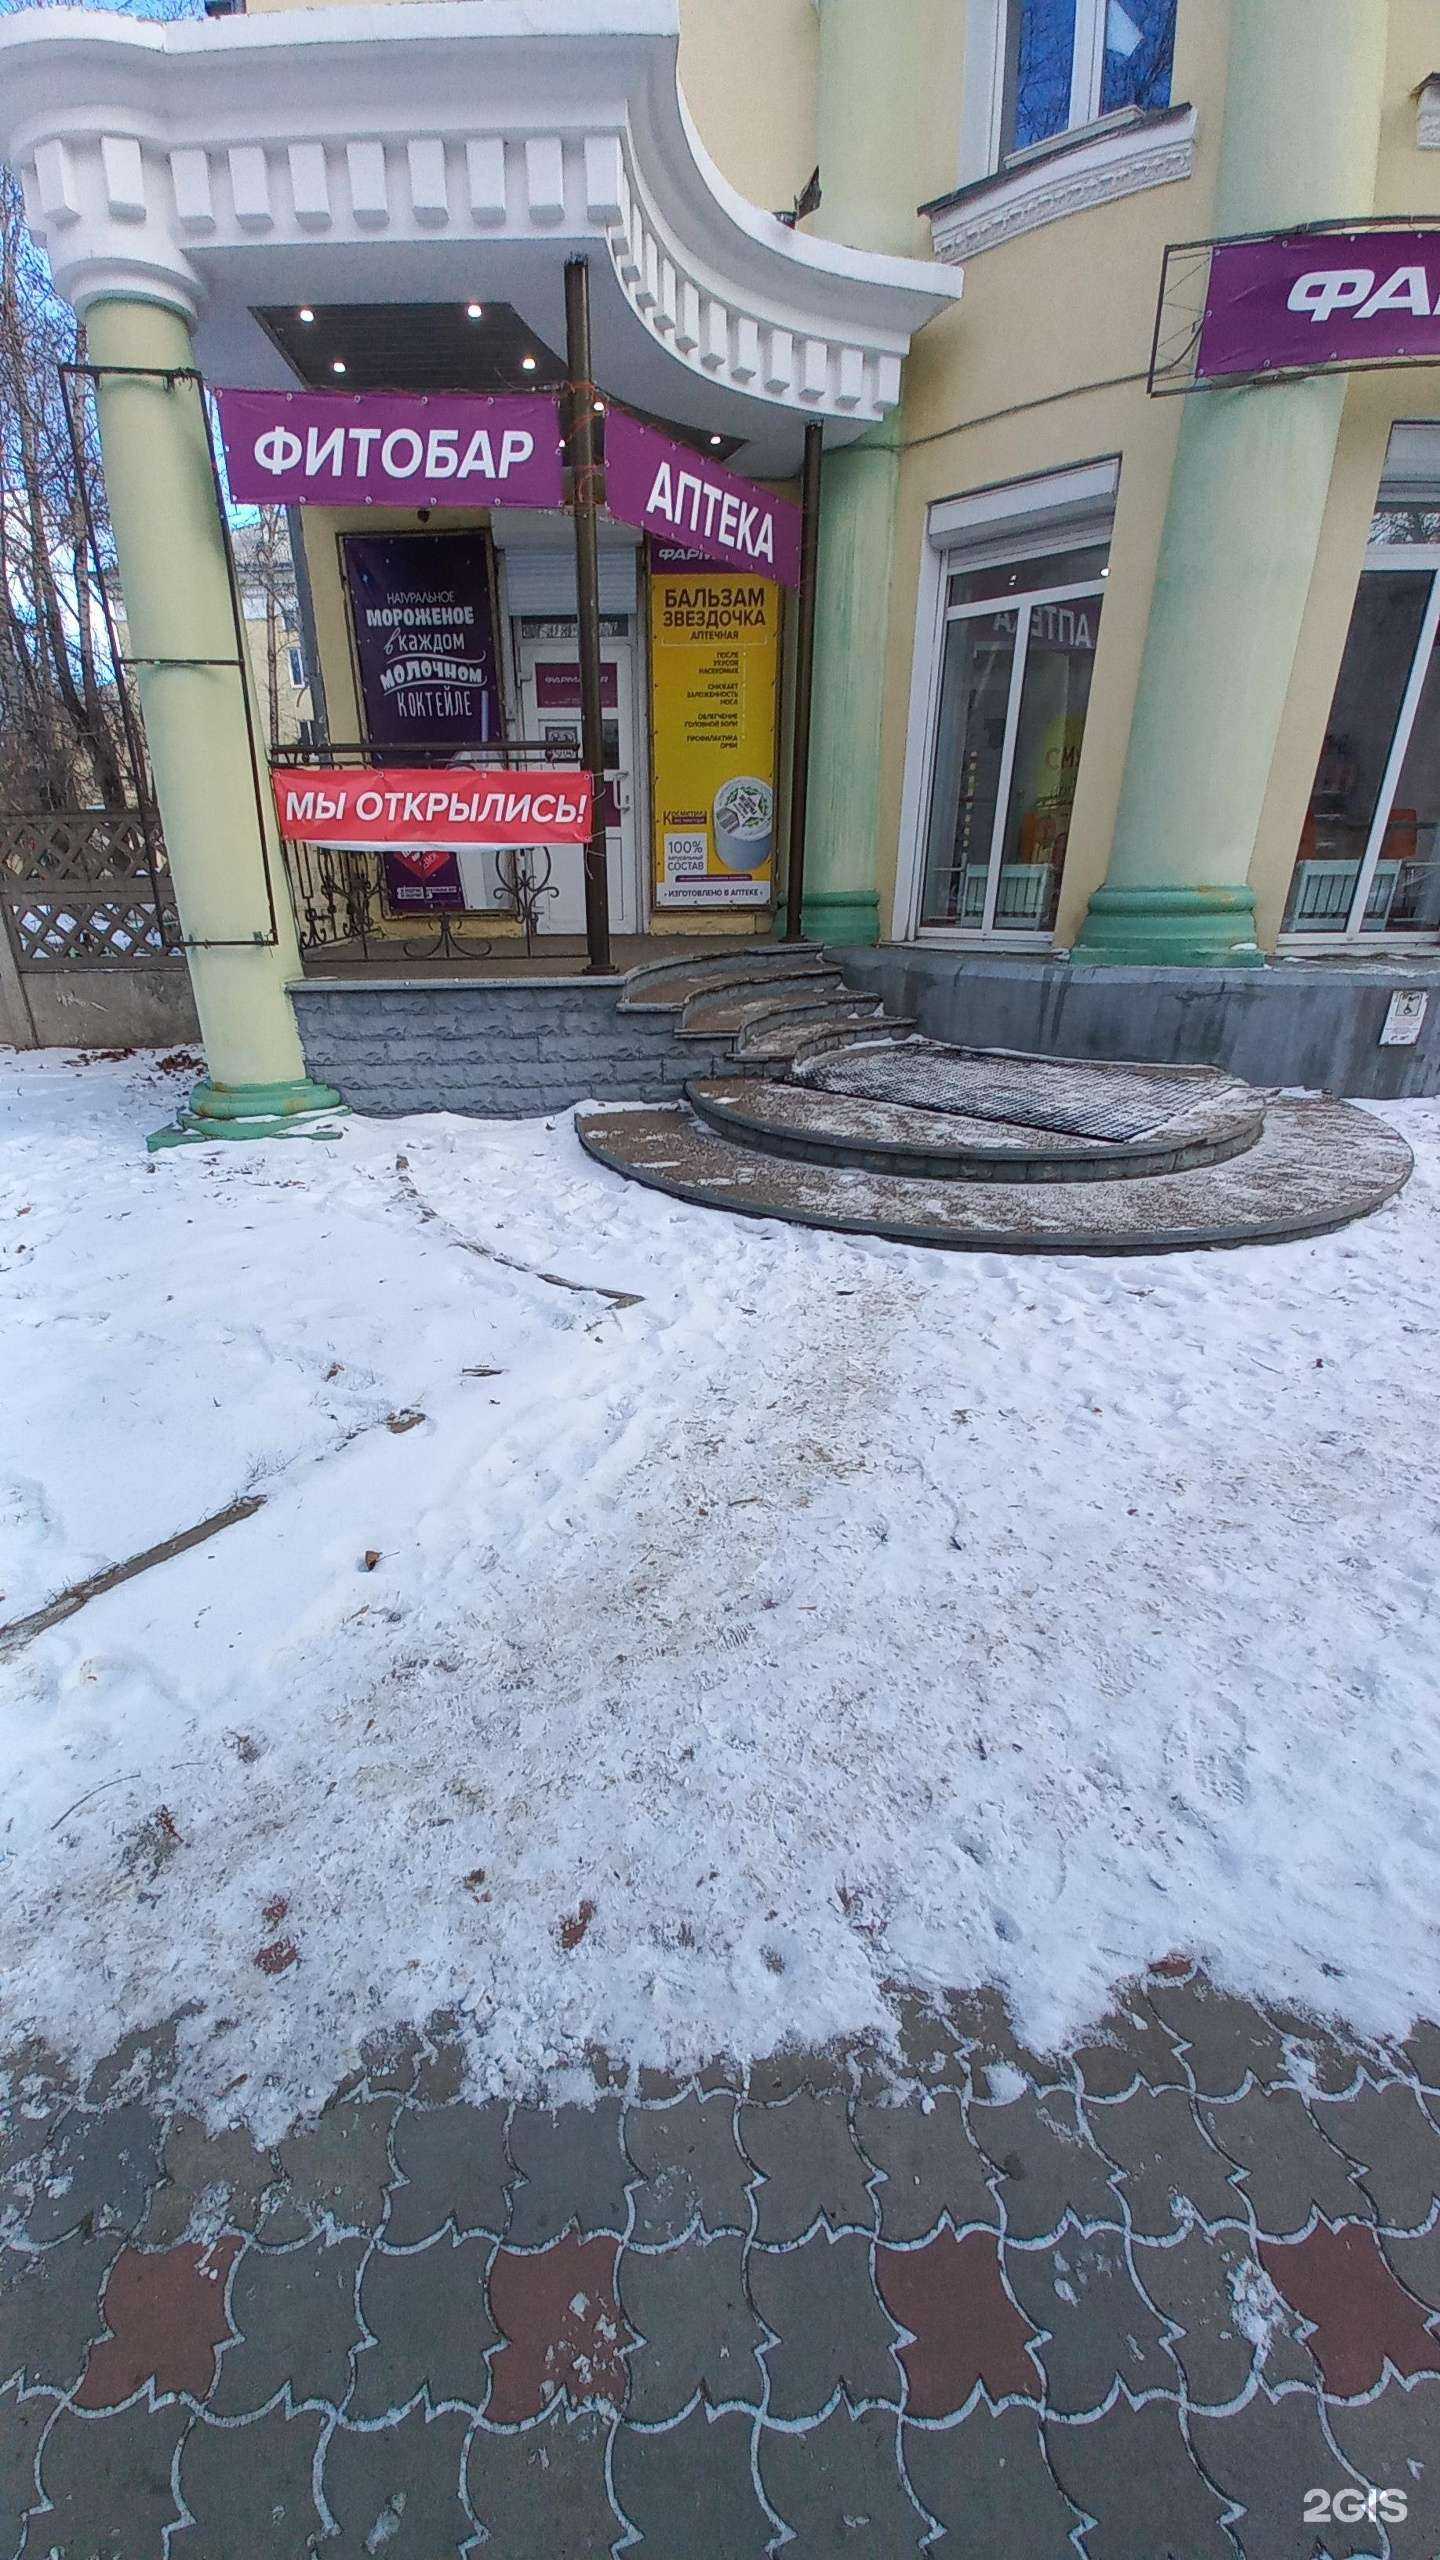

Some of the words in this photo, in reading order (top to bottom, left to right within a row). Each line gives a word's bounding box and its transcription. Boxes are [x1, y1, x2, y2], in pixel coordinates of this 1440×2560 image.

[1287, 266, 1440, 322] ФА
[253, 425, 535, 480] ФИТОБАР
[645, 461, 776, 564] АПТЕКА
[386, 590, 456, 605] НАТУРАЛЬНОЕ
[664, 587, 765, 608] БАЛЬЗАМ
[366, 606, 475, 627] МОРОЖЕНОЕ
[663, 609, 766, 629] ЗВЕЗДОЧКА
[690, 630, 739, 641] АПТЕЧНАЯ
[380, 660, 482, 690] МОЛОЧНОМ
[396, 685, 473, 717] КОКТЕЙЛЕ
[285, 791, 345, 823] МЫ
[356, 791, 587, 825] ОТКРЫЛИСЬ!
[668, 841, 703, 854] 100%
[667, 861, 705, 871] СОСТАВ
[668, 888, 722, 898] ИЗГОТОВЛЕНО
[730, 888, 759, 897] АПТЕКЕ
